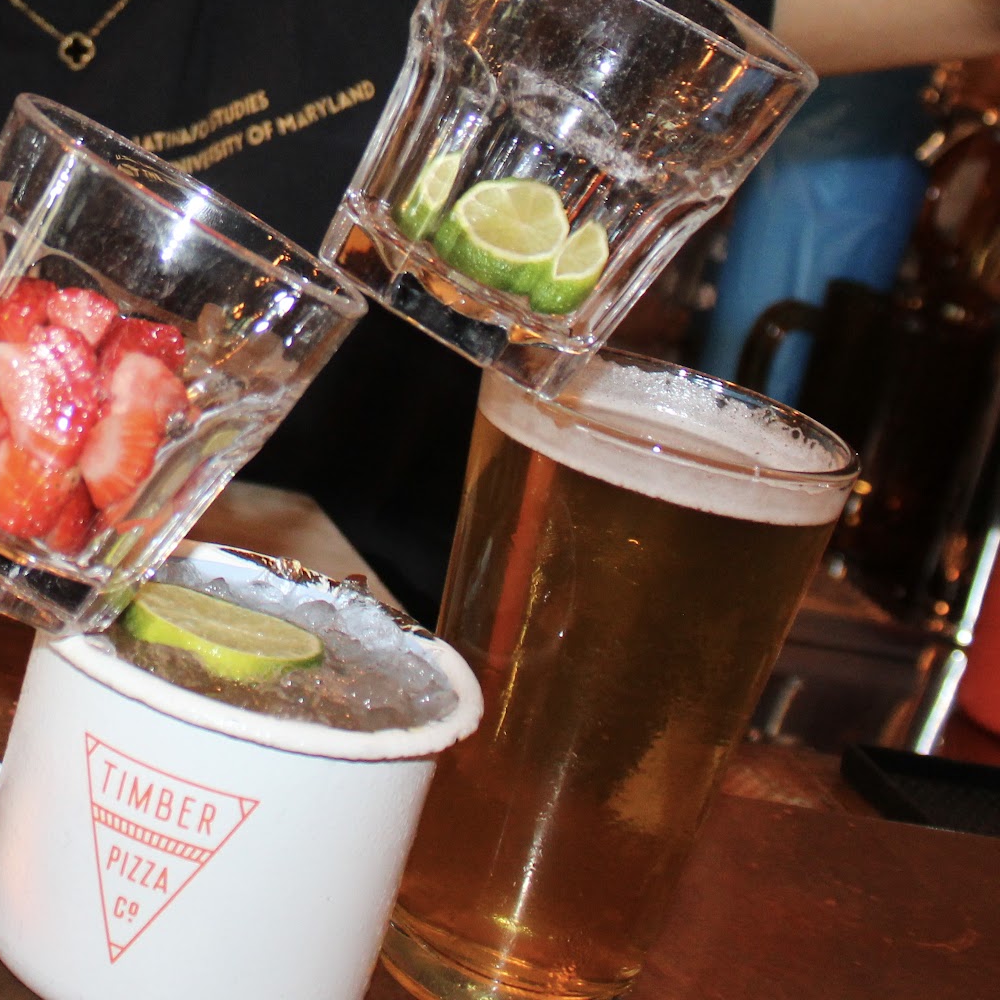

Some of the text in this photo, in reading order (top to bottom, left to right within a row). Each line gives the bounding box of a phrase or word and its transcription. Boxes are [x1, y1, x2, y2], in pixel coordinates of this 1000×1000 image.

[168, 131, 244, 175] NIVERSITY
[245, 119, 274, 147] OF
[275, 79, 376, 136] MARYLAND
[206, 89, 270, 134] STUDIES
[102, 759, 217, 836] TIMBER
[106, 844, 169, 894] PIZZA
